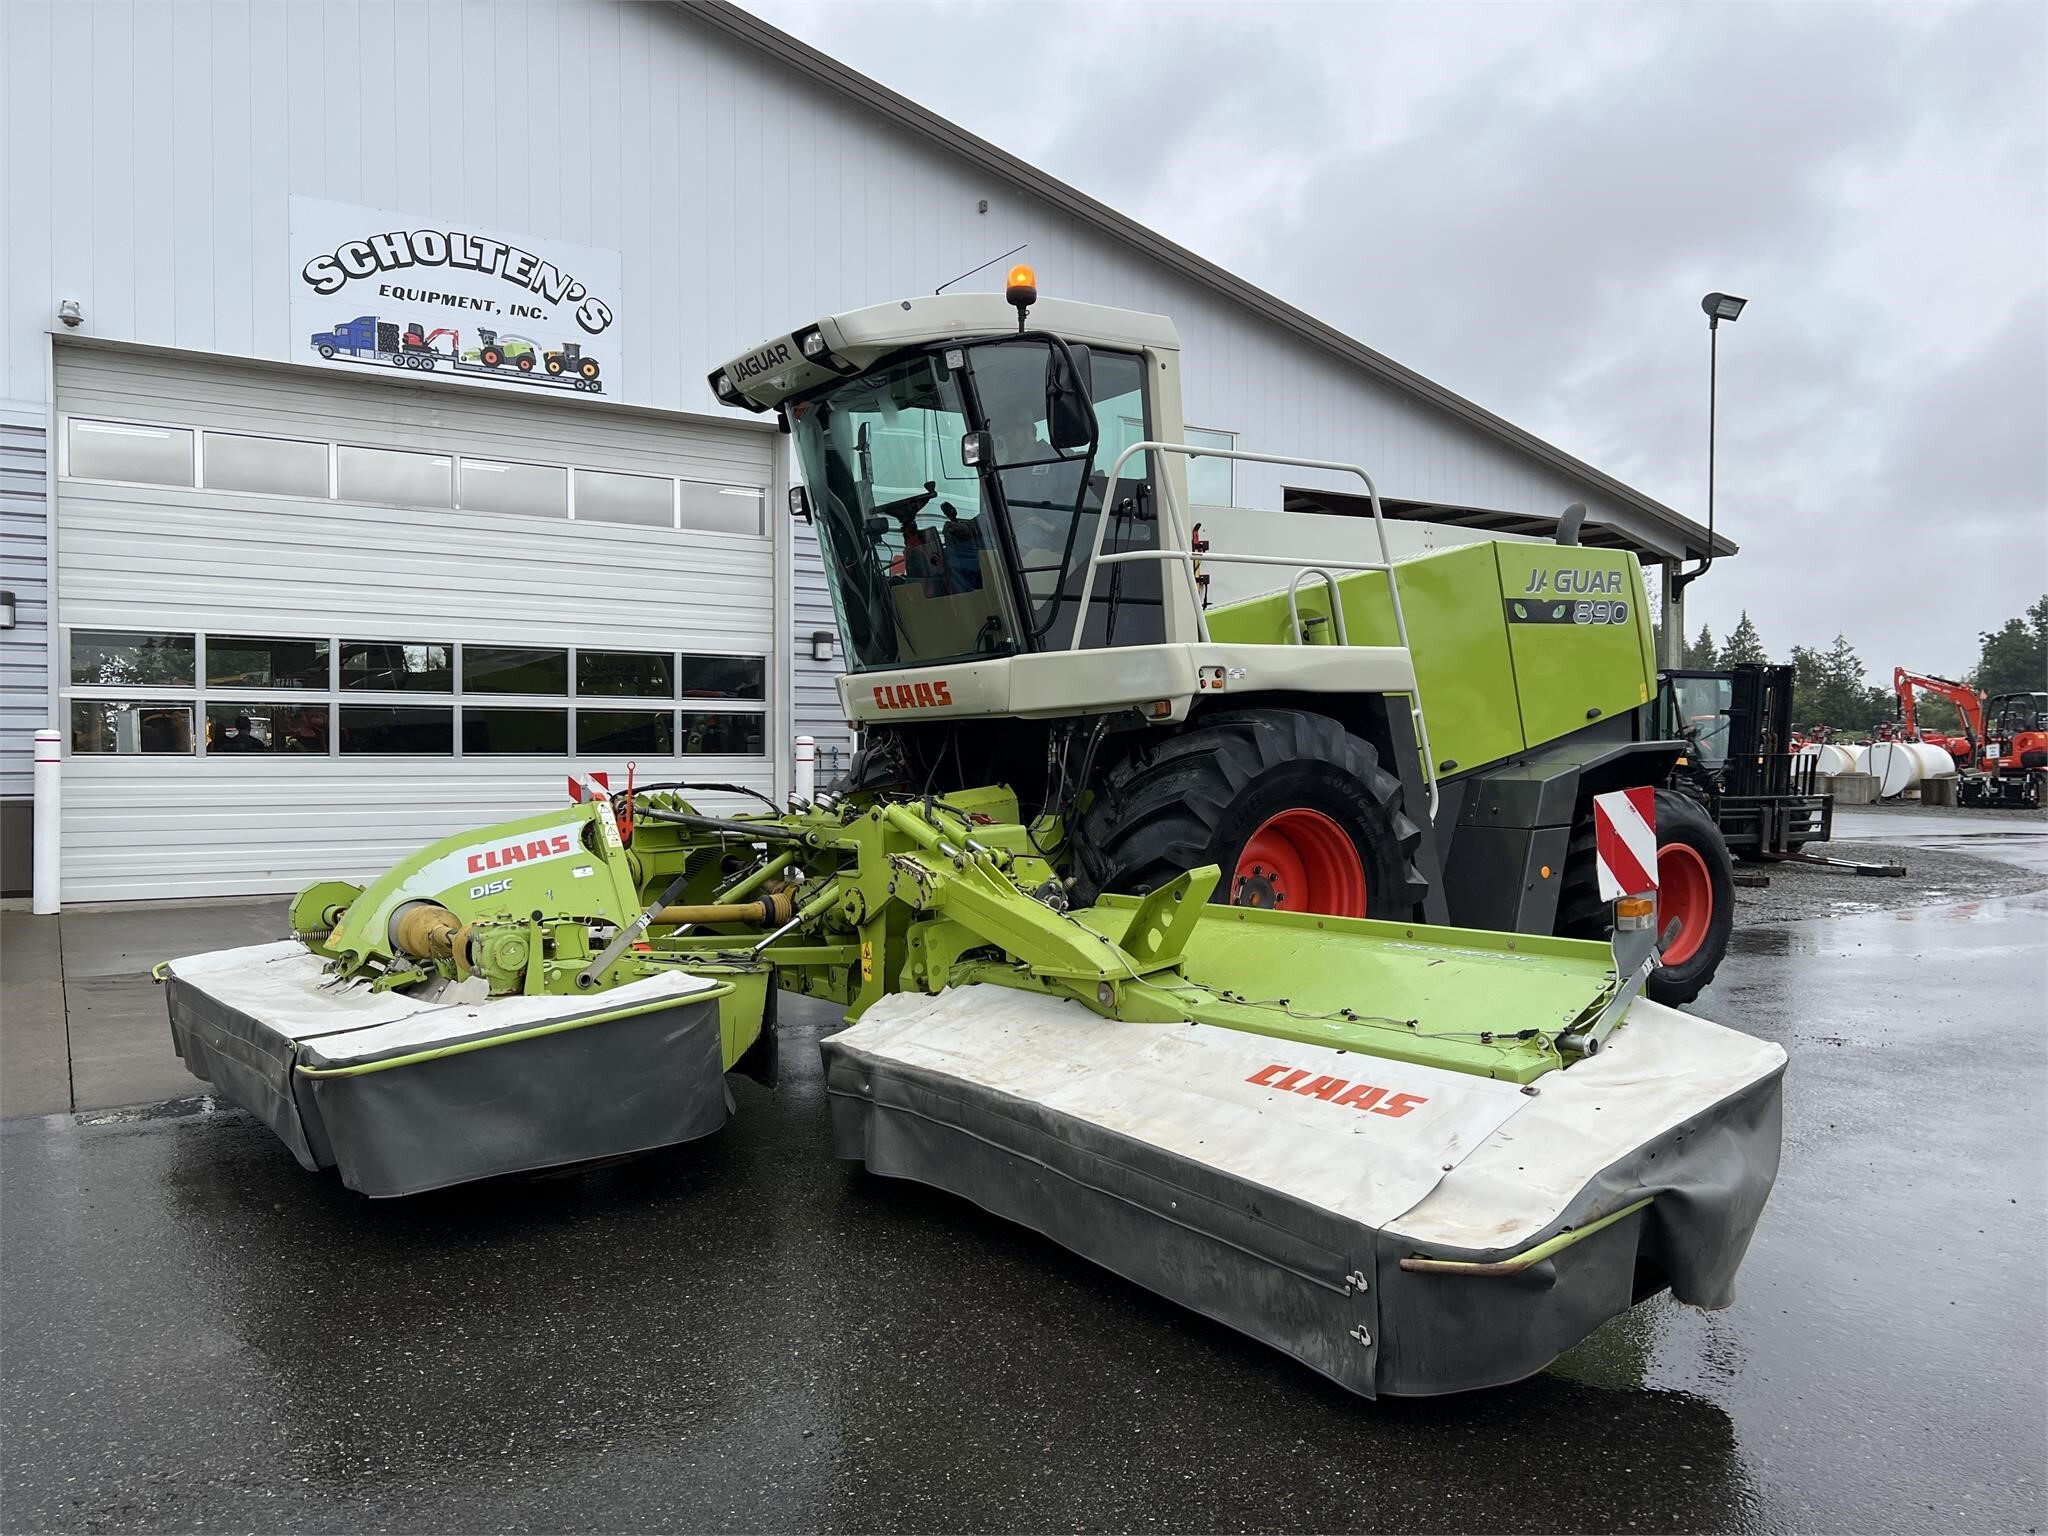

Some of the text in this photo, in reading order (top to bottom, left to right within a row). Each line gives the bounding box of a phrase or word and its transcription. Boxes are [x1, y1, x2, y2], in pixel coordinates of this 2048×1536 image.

[302, 229, 613, 335] SCHOLTEN'S
[378, 284, 548, 320] EQUIPMENT, INC.
[733, 343, 791, 383] JAGUAR
[1572, 599, 1629, 625] 890
[873, 681, 953, 709] CLAAS
[467, 835, 570, 873] CLAAS
[1244, 1064, 1429, 1118] CLAAS
